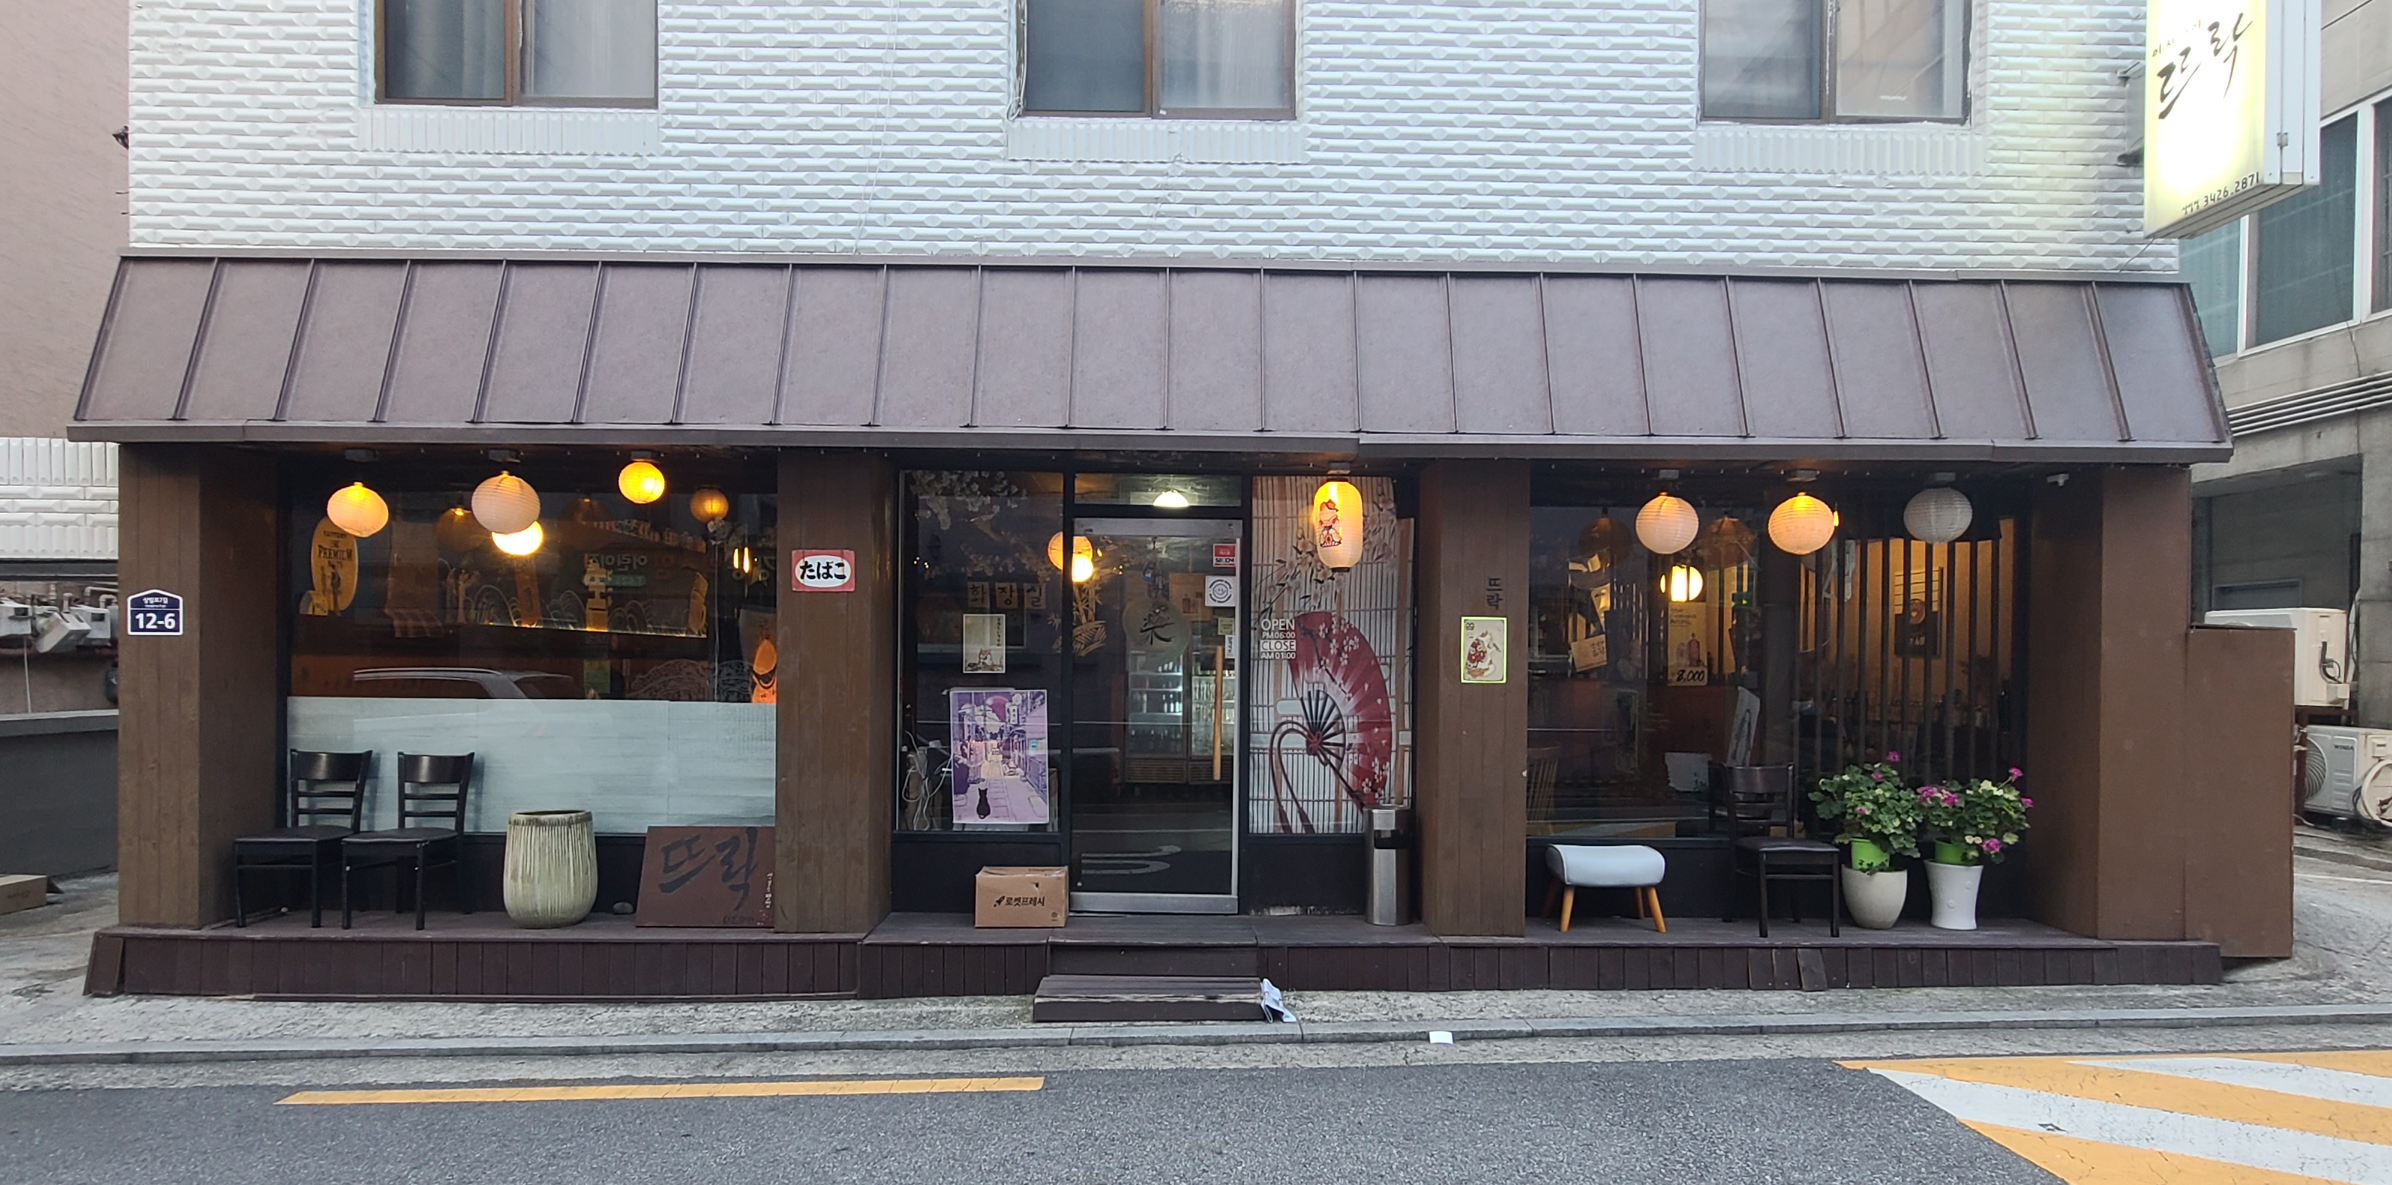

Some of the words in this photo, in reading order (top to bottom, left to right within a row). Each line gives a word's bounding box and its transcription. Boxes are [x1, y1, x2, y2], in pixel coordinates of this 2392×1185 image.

[2203, 171, 2260, 208] 3426.2871
[799, 560, 847, 580] たばこ
[969, 584, 1042, 608] 화장실
[1486, 577, 1503, 610] 뜨락
[135, 613, 176, 630] 12-6
[1261, 619, 1296, 631] OPEN
[1262, 631, 1274, 639] PM
[1274, 631, 1296, 639] 06:00
[1261, 640, 1296, 651] CLOSE
[1261, 652, 1274, 660] AM
[659, 827, 758, 911] 뜨락
[1005, 896, 1045, 907] 로켓프레시
